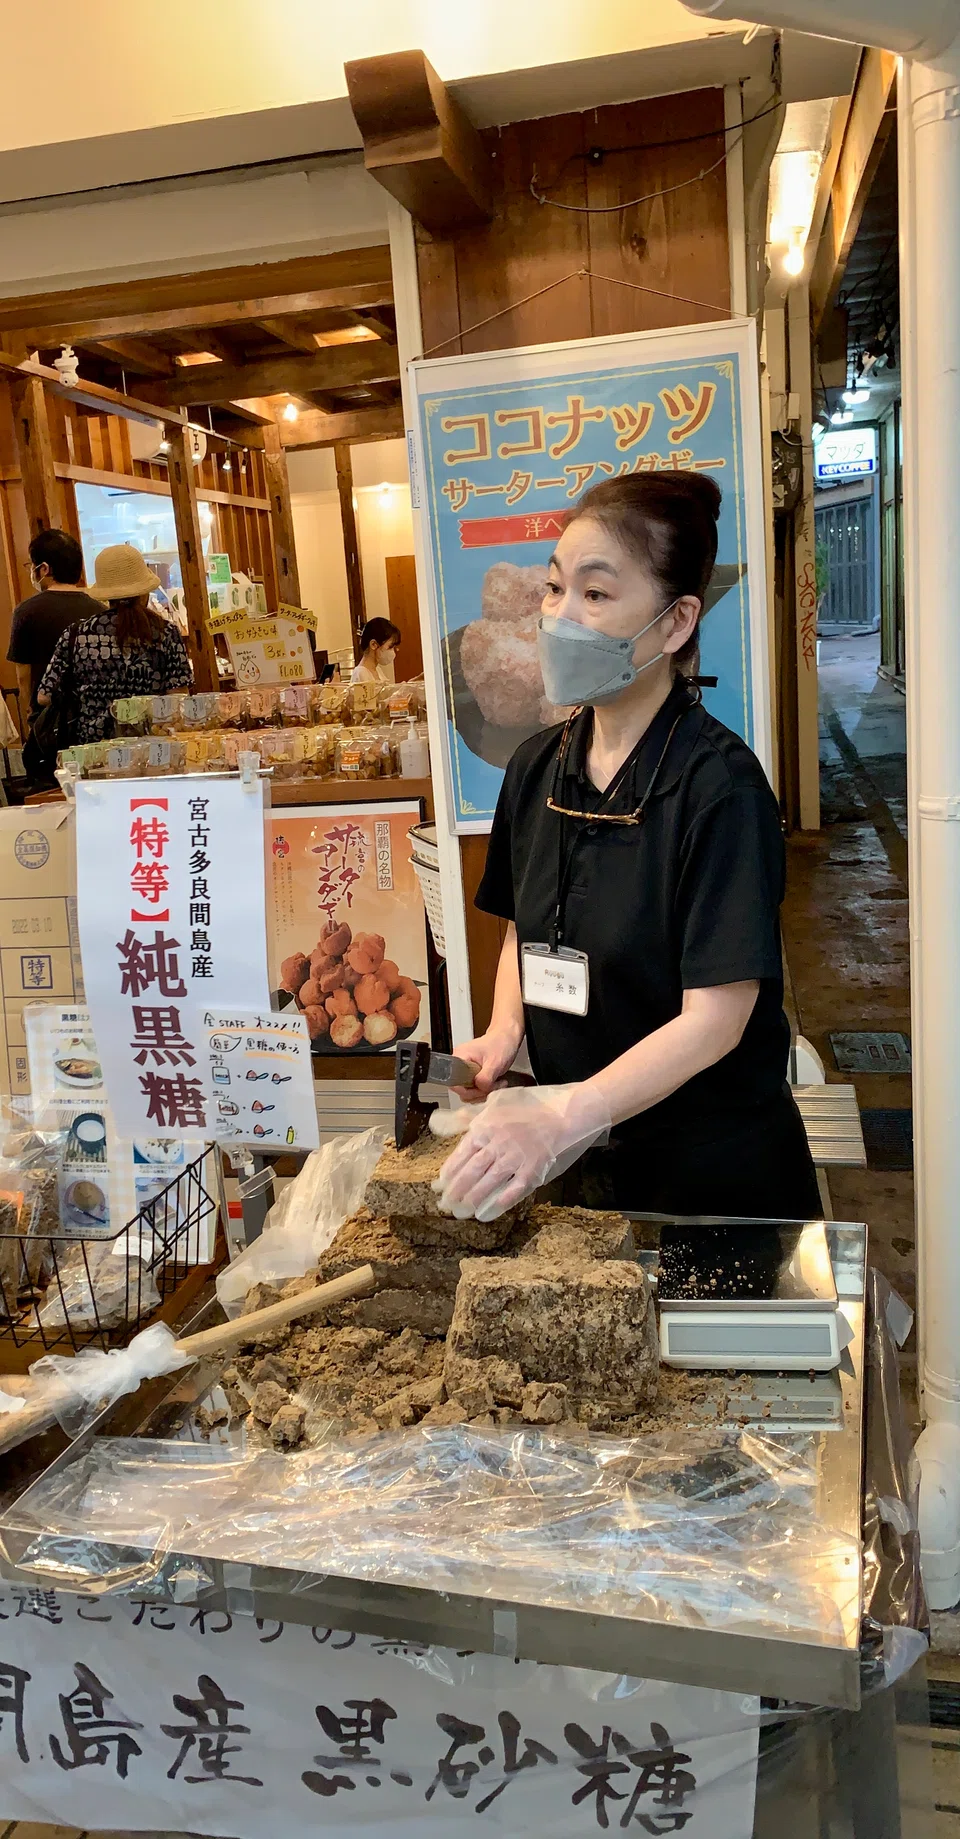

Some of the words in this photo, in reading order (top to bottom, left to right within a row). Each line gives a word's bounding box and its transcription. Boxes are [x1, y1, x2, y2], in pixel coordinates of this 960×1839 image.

[441, 382, 717, 466] ココナッツ
[188, 796, 214, 979] 宮古多良間島産
[375, 823, 392, 888] 那覇の名物
[28, 958, 46, 986] 特等
[219, 1019, 246, 1028] STAFF
[300, 1697, 697, 1836] 黒砂糖
